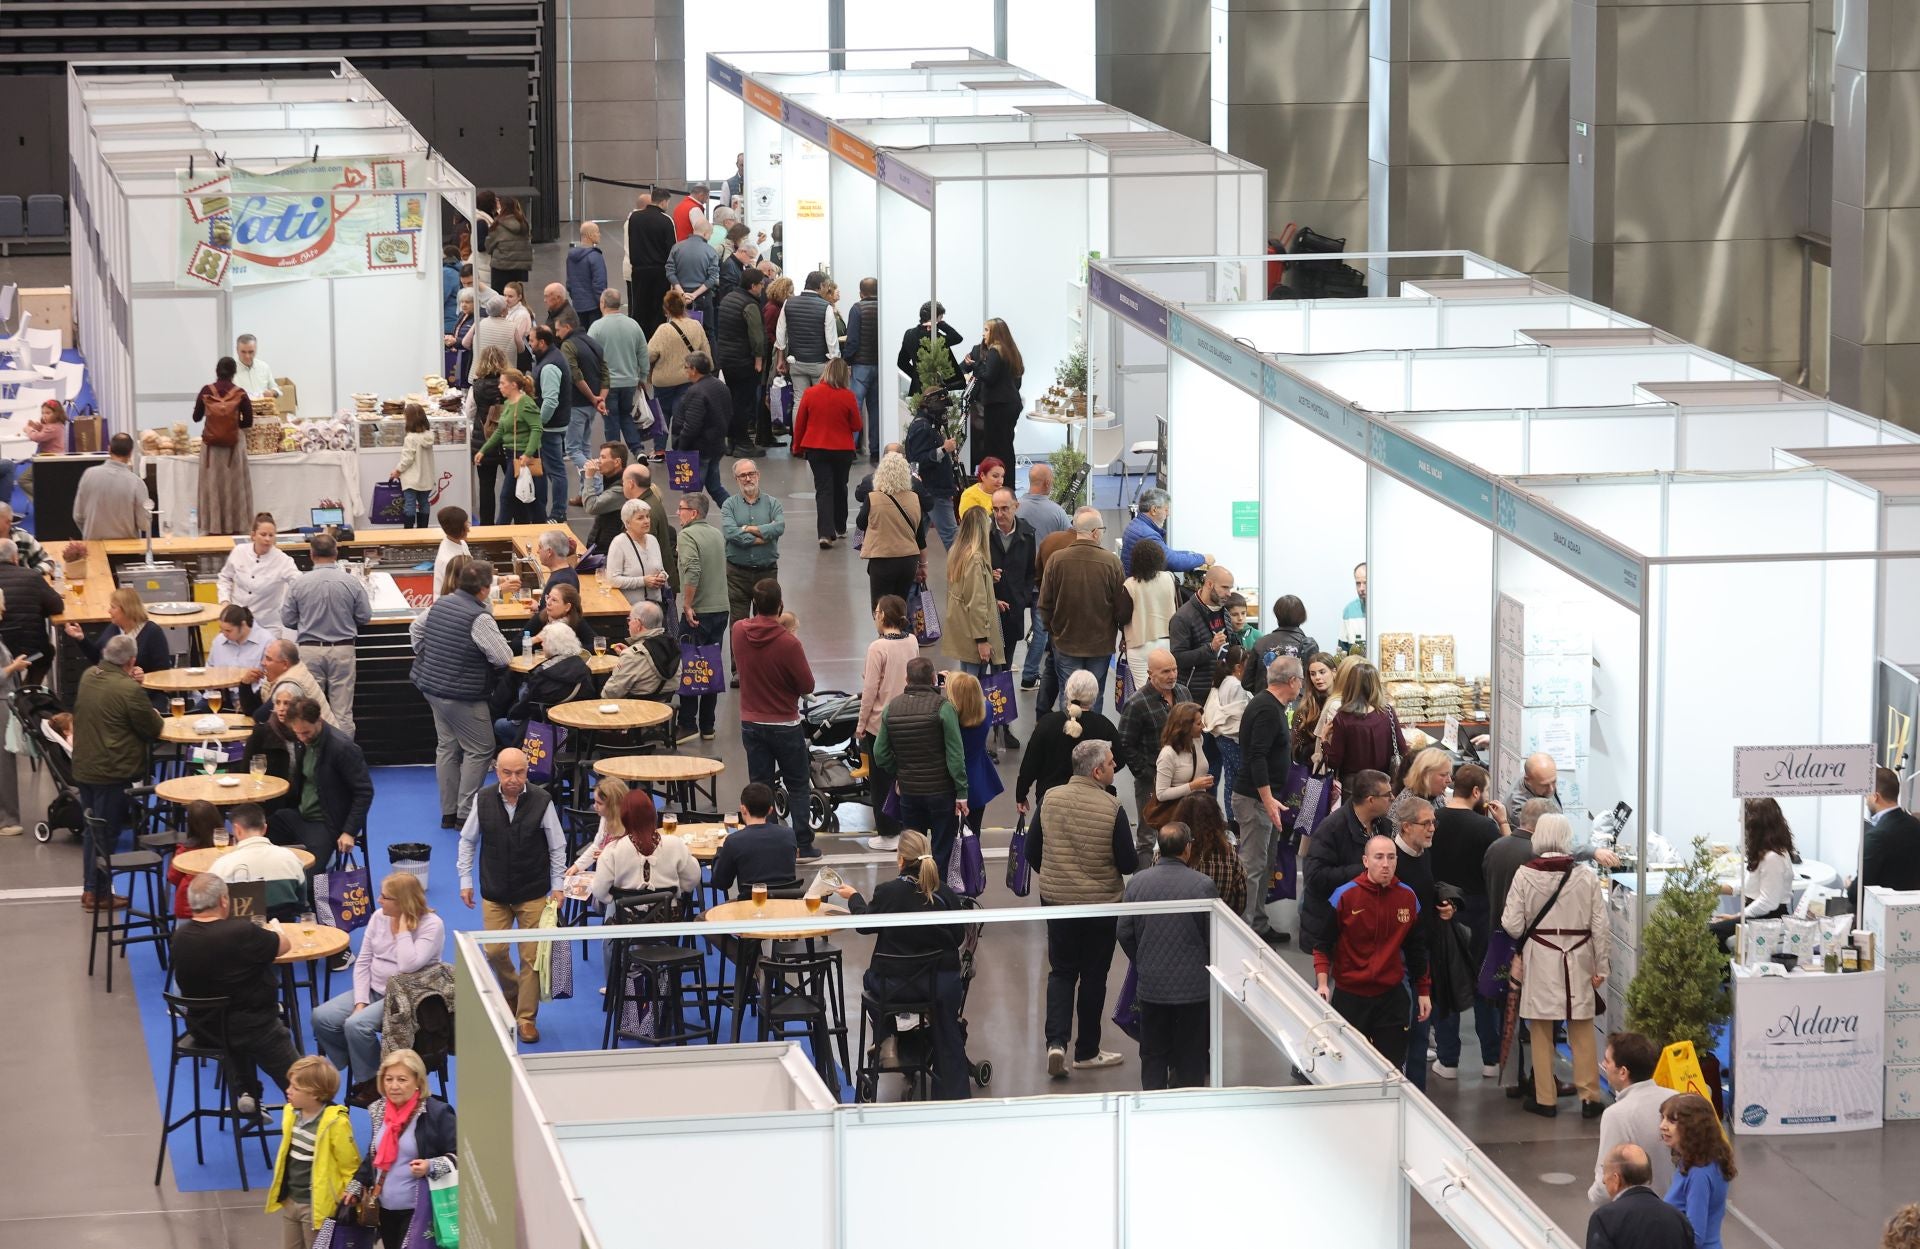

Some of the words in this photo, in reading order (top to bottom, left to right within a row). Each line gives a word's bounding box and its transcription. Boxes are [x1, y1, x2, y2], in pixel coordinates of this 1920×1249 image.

[1553, 531, 1567, 547] SNACK
[1567, 540, 1582, 555] ADARA
[1763, 752, 1846, 781] Adara
[1766, 1004, 1860, 1039] Adara
